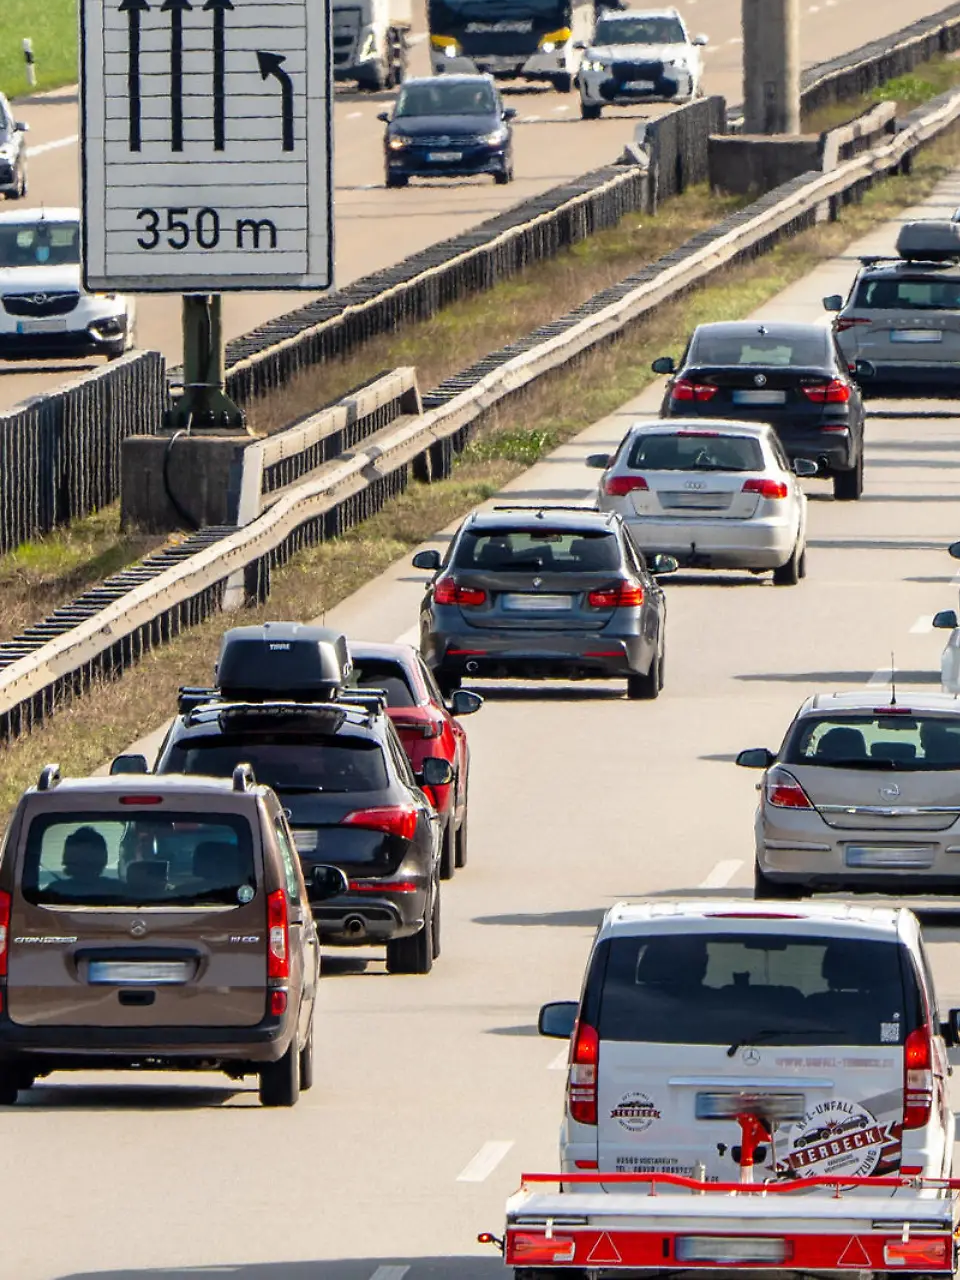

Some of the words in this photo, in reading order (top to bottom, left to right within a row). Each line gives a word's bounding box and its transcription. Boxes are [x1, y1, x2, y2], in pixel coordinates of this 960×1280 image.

[136, 207, 220, 250] 350
[236, 218, 277, 248] m
[795, 1131, 876, 1166] TERBECK
